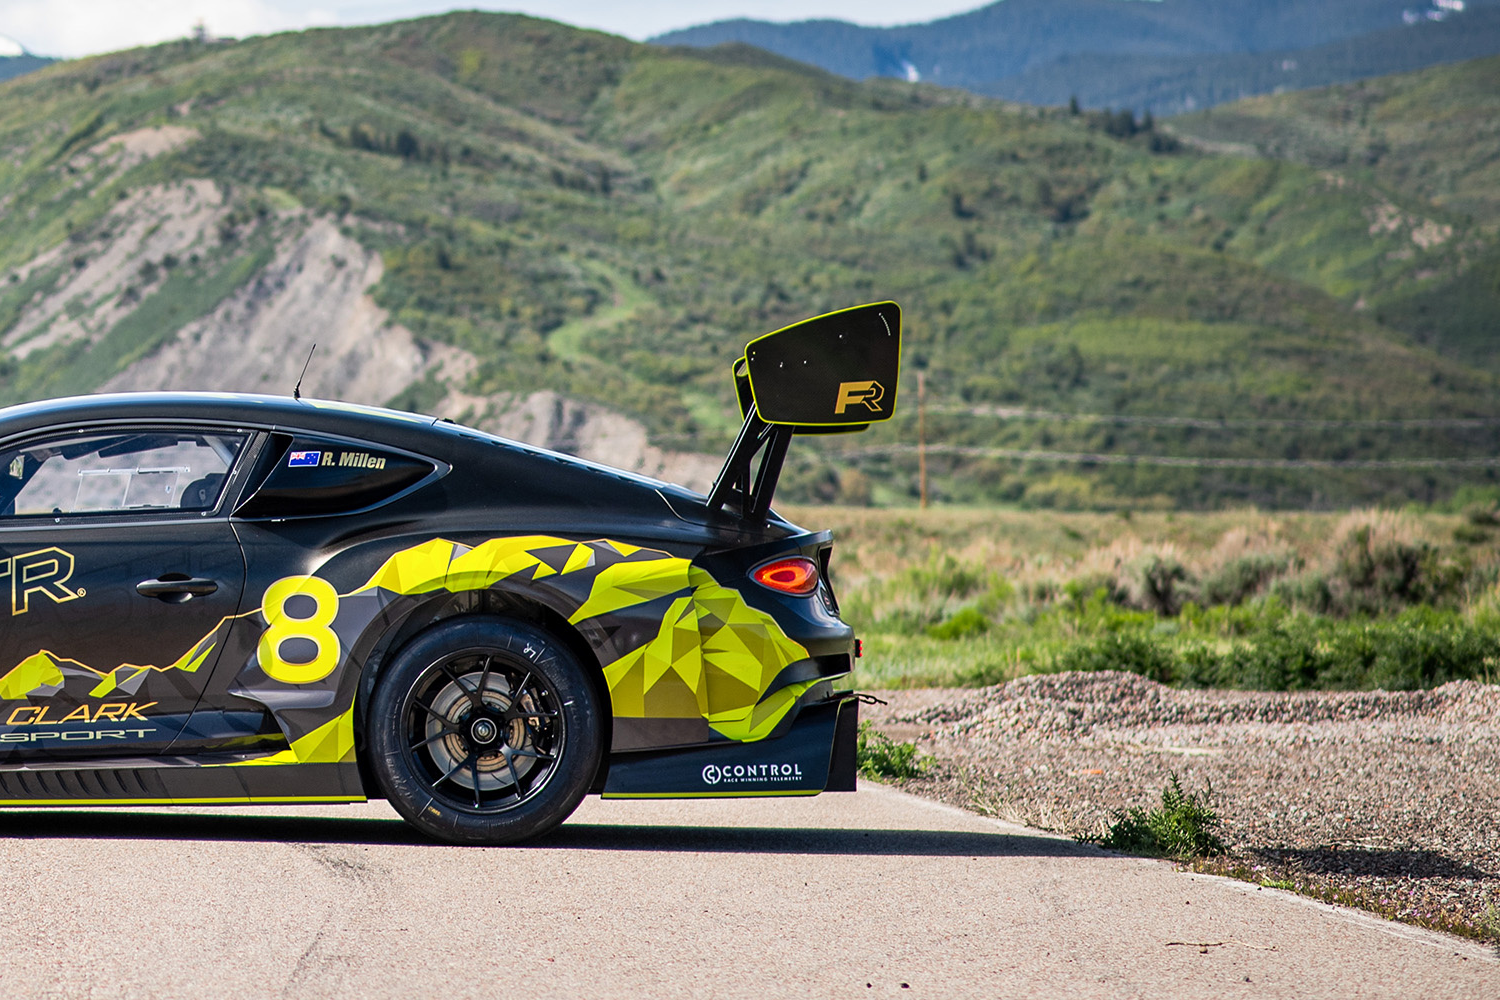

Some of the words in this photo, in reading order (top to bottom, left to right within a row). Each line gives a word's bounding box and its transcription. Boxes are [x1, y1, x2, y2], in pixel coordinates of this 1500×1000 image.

[321, 452, 336, 466] R.
[339, 452, 386, 470] Millen
[257, 574, 341, 685] 8
[6, 701, 158, 726] CLARK
[722, 764, 802, 777] CONTROL
